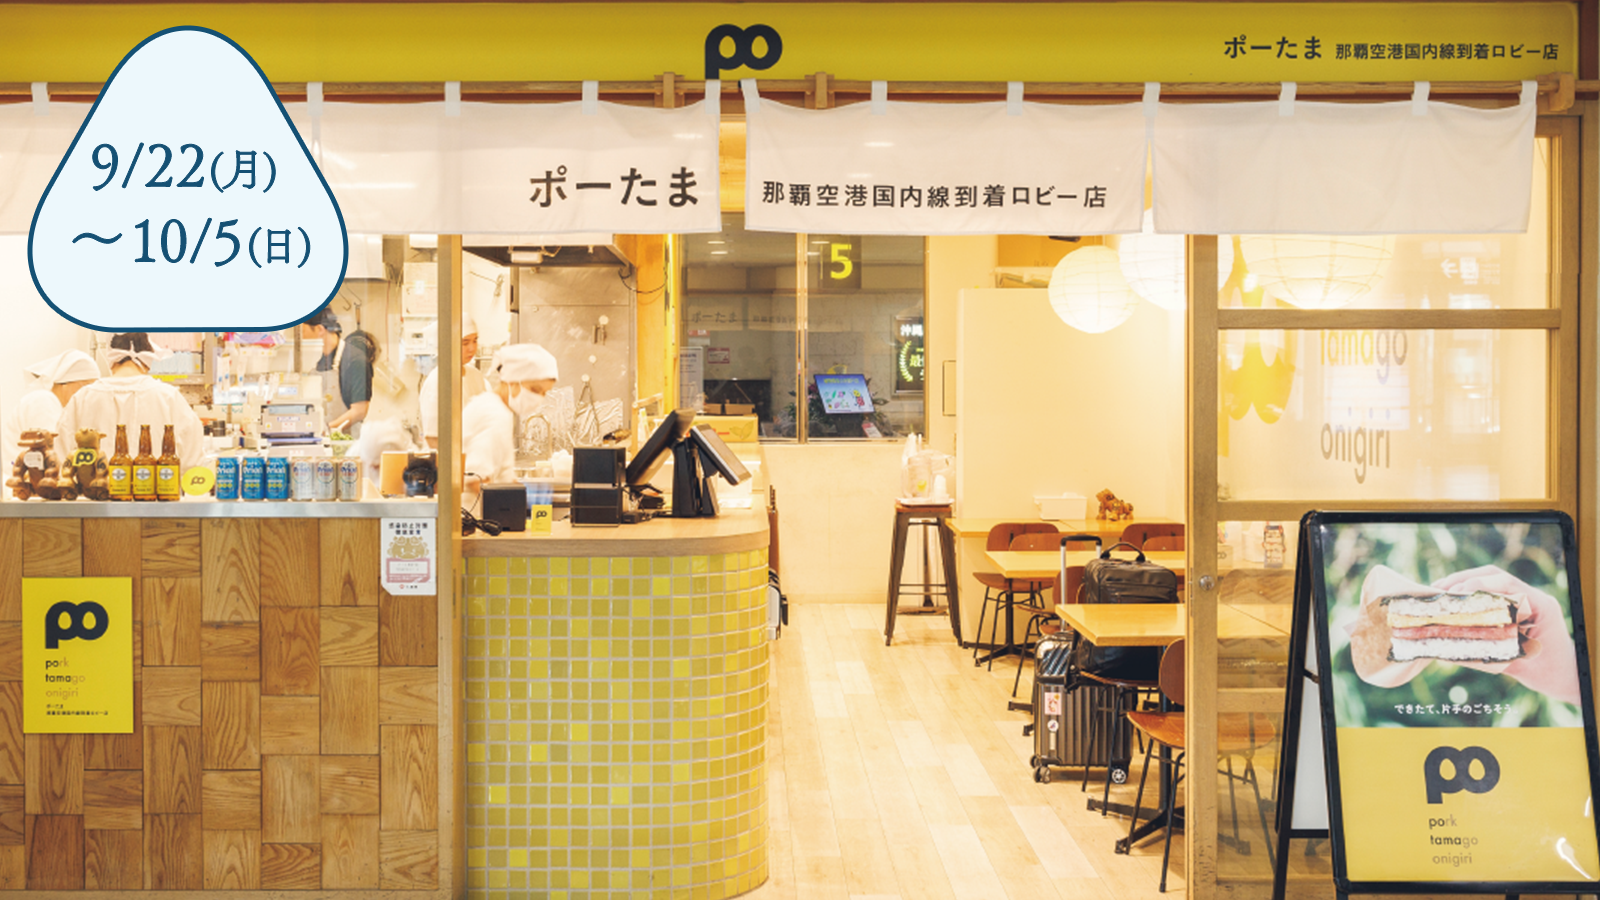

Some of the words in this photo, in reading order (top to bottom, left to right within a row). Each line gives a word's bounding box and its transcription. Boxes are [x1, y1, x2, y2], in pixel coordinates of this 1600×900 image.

[705, 24, 783, 79] po
[1224, 34, 1322, 59] ポーたま
[1335, 43, 1559, 60] 那覇空港国内線到着ロビー店
[530, 165, 698, 208] ポーたま
[763, 181, 1107, 208] 那覇空港国内線到着ロビー店
[830, 243, 853, 280] 5
[1320, 406, 1390, 484] onigiri
[45, 601, 109, 649] po
[45, 656, 69, 670] pork
[45, 673, 86, 685] tamago
[45, 687, 79, 700] onigiri
[1424, 745, 1501, 804] po
[1429, 814, 1458, 830] pork
[1430, 835, 1479, 849] tamago
[1432, 852, 1473, 867] onigiri
